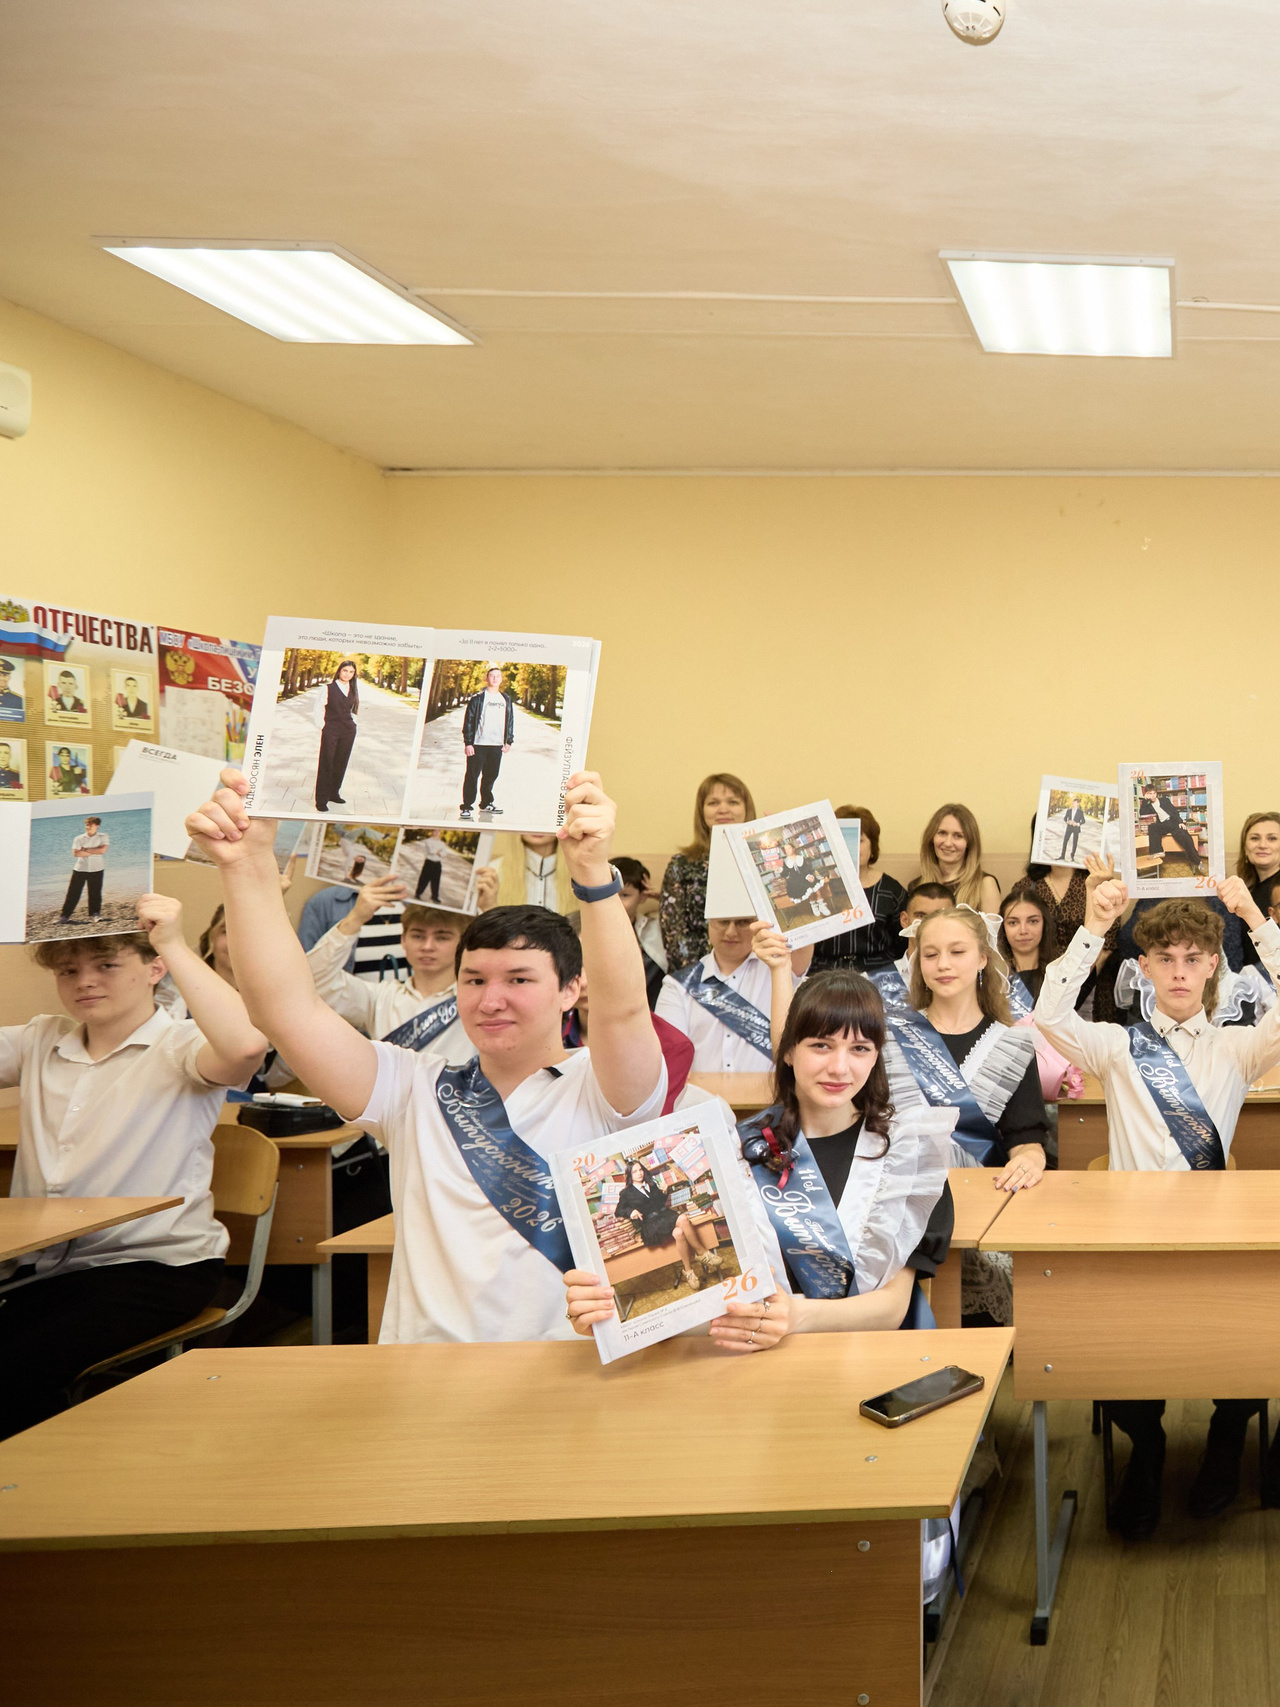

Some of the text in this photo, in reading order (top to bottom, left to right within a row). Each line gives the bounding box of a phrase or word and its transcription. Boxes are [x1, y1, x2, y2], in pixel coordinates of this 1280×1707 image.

[33, 606, 153, 654] ОТЕЧЕСТВА
[328, 637, 355, 645] которых
[356, 639, 397, 647] невозможно
[207, 676, 255, 695] БЕЗО
[141, 746, 178, 761] ВСЕГДА
[254, 734, 265, 758] ЭЛЕН
[1194, 874, 1217, 889] 26
[842, 904, 864, 924] 26
[573, 1152, 595, 1172] 20
[500, 1196, 562, 1233] 2026
[722, 1266, 758, 1301] 26
[624, 1321, 665, 1342] 11-А класс
